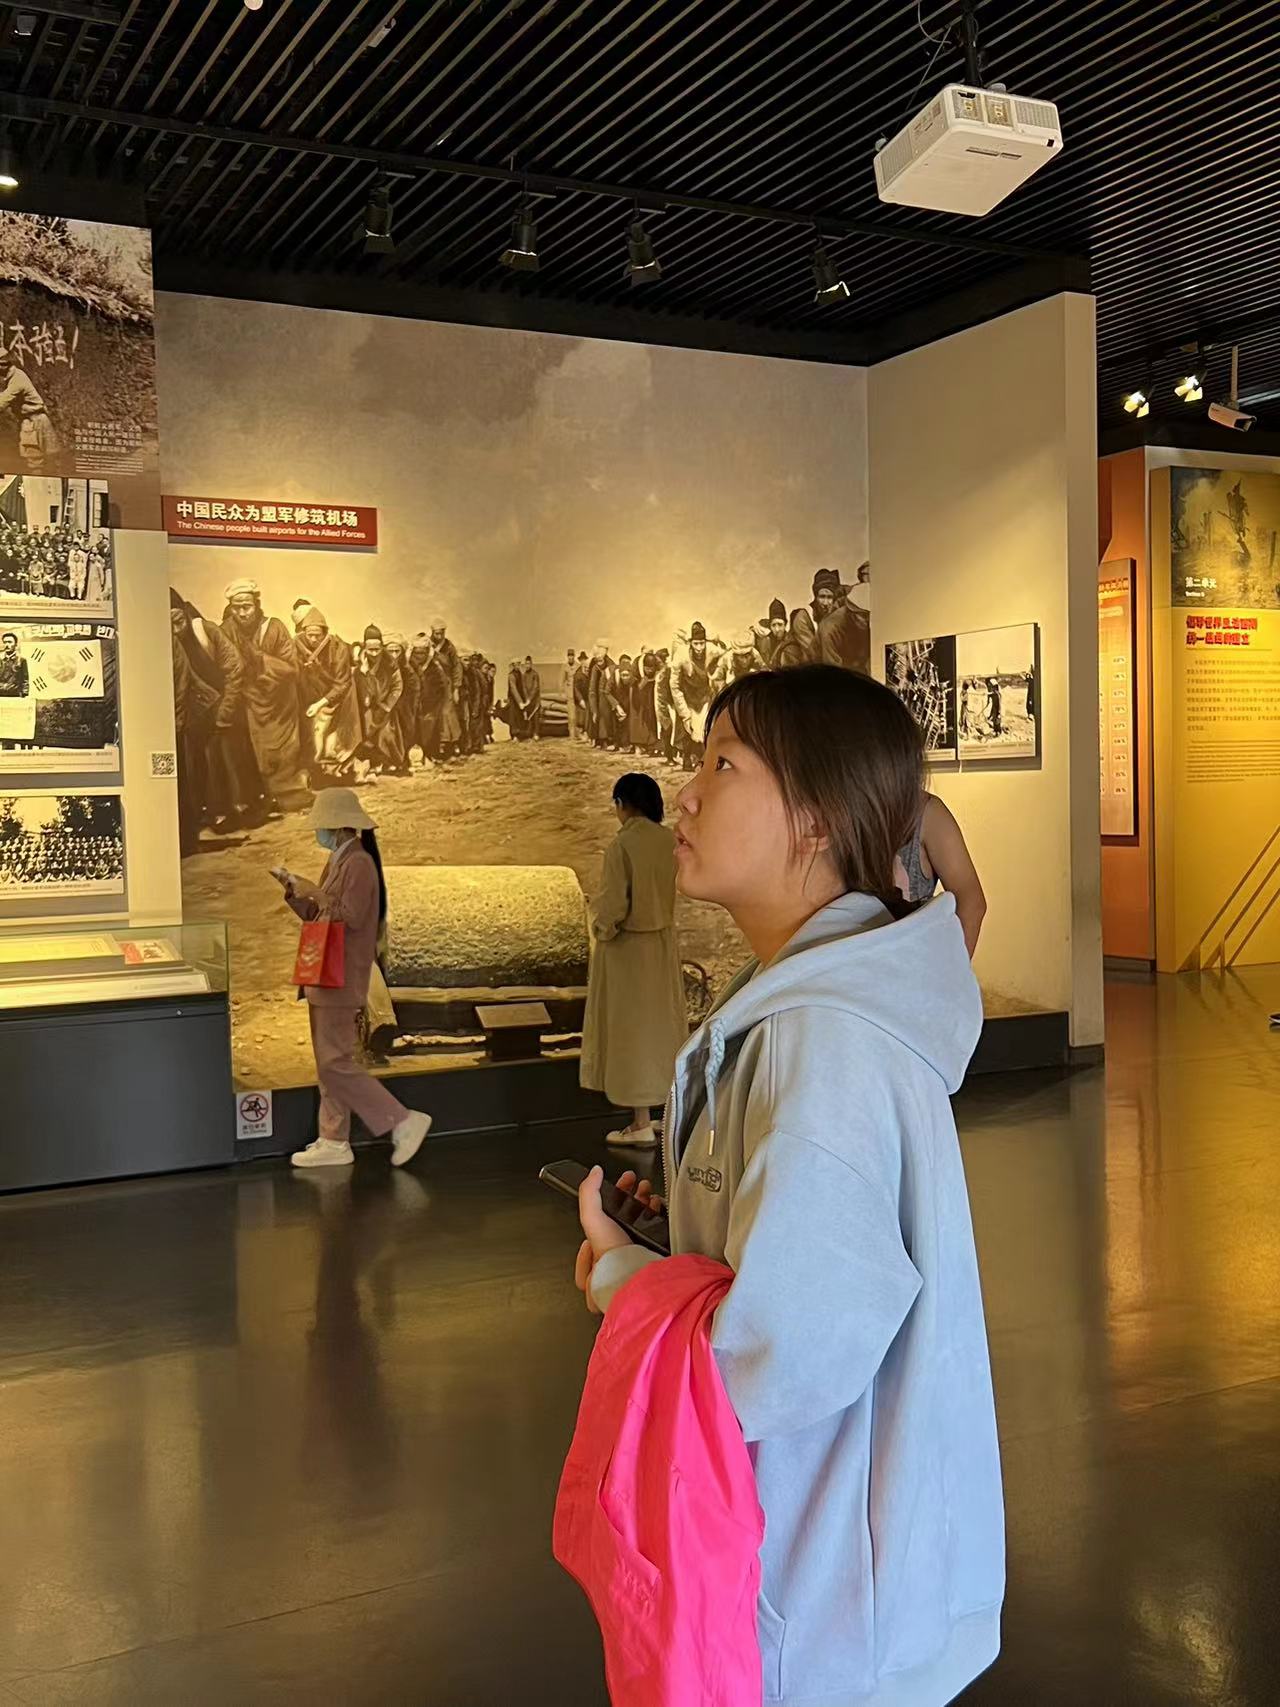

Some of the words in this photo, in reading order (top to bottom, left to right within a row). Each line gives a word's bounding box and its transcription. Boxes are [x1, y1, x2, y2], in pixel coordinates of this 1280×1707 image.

[176, 500, 358, 527] 中国民众为盟军修筑机场
[177, 520, 192, 529] The
[193, 521, 224, 531] Chinese
[226, 524, 250, 533] people
[252, 524, 268, 533] built
[269, 526, 296, 536] airports
[297, 527, 307, 535] for
[308, 527, 320, 536] the
[321, 528, 340, 538] Allied
[342, 529, 366, 539] Forces
